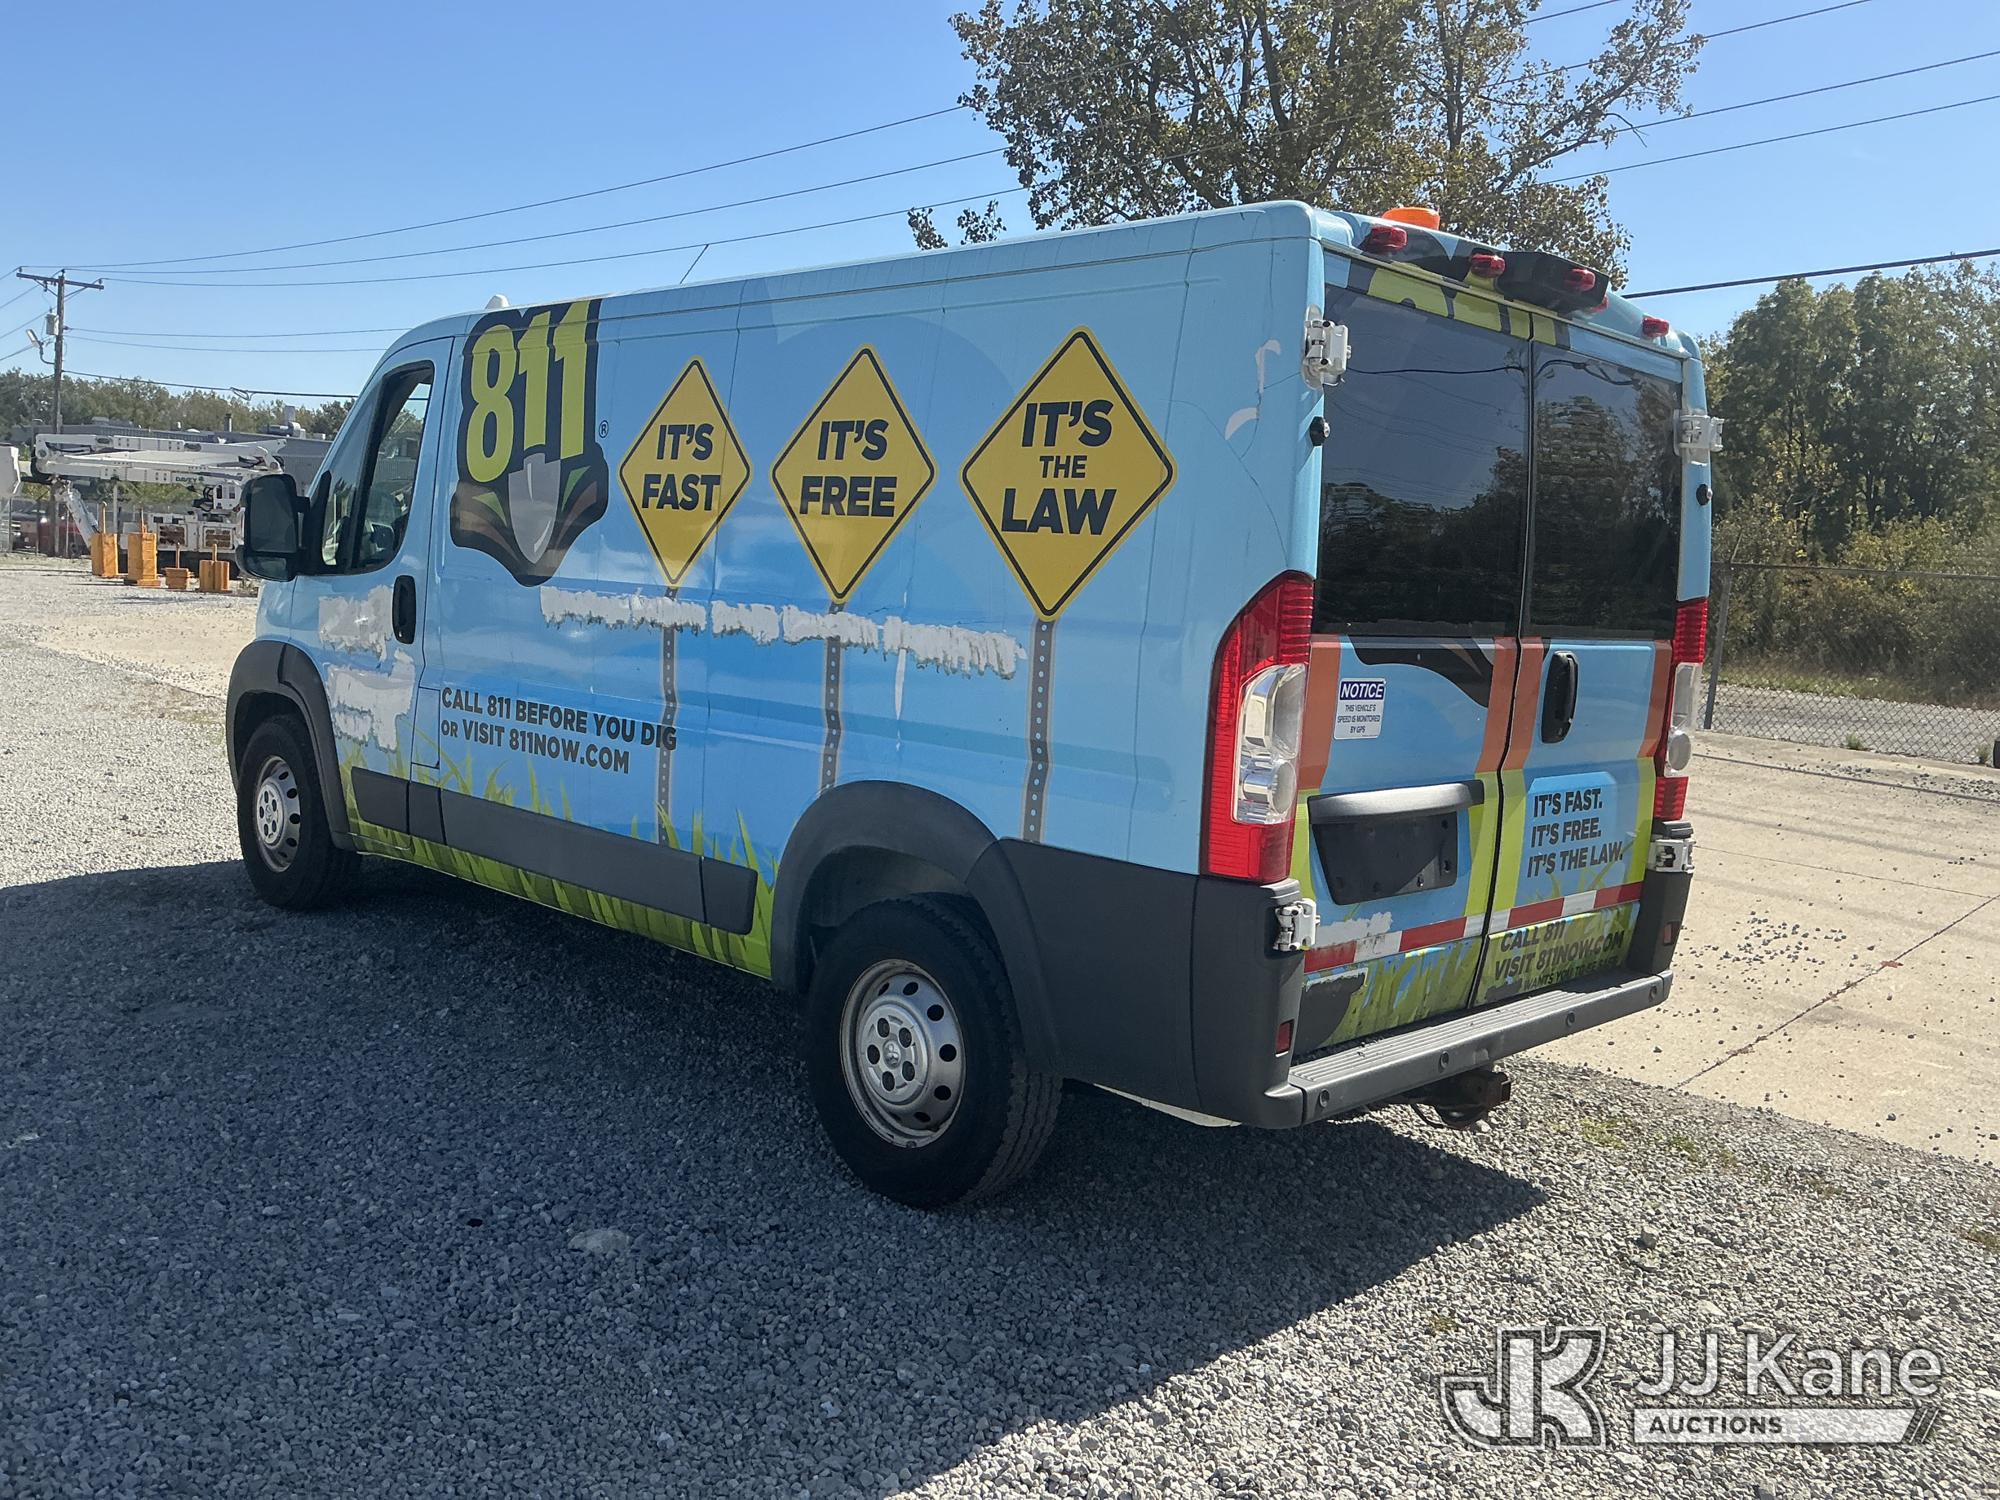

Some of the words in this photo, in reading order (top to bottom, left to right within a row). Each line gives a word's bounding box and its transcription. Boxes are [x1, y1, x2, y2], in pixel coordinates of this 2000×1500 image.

[466, 300, 591, 483] 811
[656, 423, 713, 460] IT'S
[817, 419, 889, 461] IT'S
[1021, 399, 1114, 447] IT'S
[1040, 455, 1088, 479] THE
[641, 473, 721, 511] FAST
[799, 476, 897, 517] FREE
[1001, 488, 1117, 535] LAW
[1341, 684, 1384, 698] NOTICE
[441, 687, 483, 714] CALL
[487, 695, 511, 719] 811
[516, 700, 588, 733] BEFORE
[594, 713, 635, 742] YOU
[641, 722, 677, 750] DIG
[441, 719, 458, 737] OR
[463, 719, 505, 747] VISIT
[509, 728, 630, 774] 811NOW.COM
[1533, 792, 1561, 817] IT'S
[1565, 787, 1603, 814] FAST.
[1530, 823, 1559, 848] IT'S
[1563, 817, 1602, 843] FREE.
[1527, 852, 1556, 878] IT'S
[1560, 847, 1588, 871] THE
[1590, 841, 1624, 865] LAW.
[1495, 952, 1535, 981] VISIT
[1536, 930, 1625, 972] 811NOW.COM
[1501, 926, 1540, 952] CALL
[1544, 921, 1567, 942] 811
